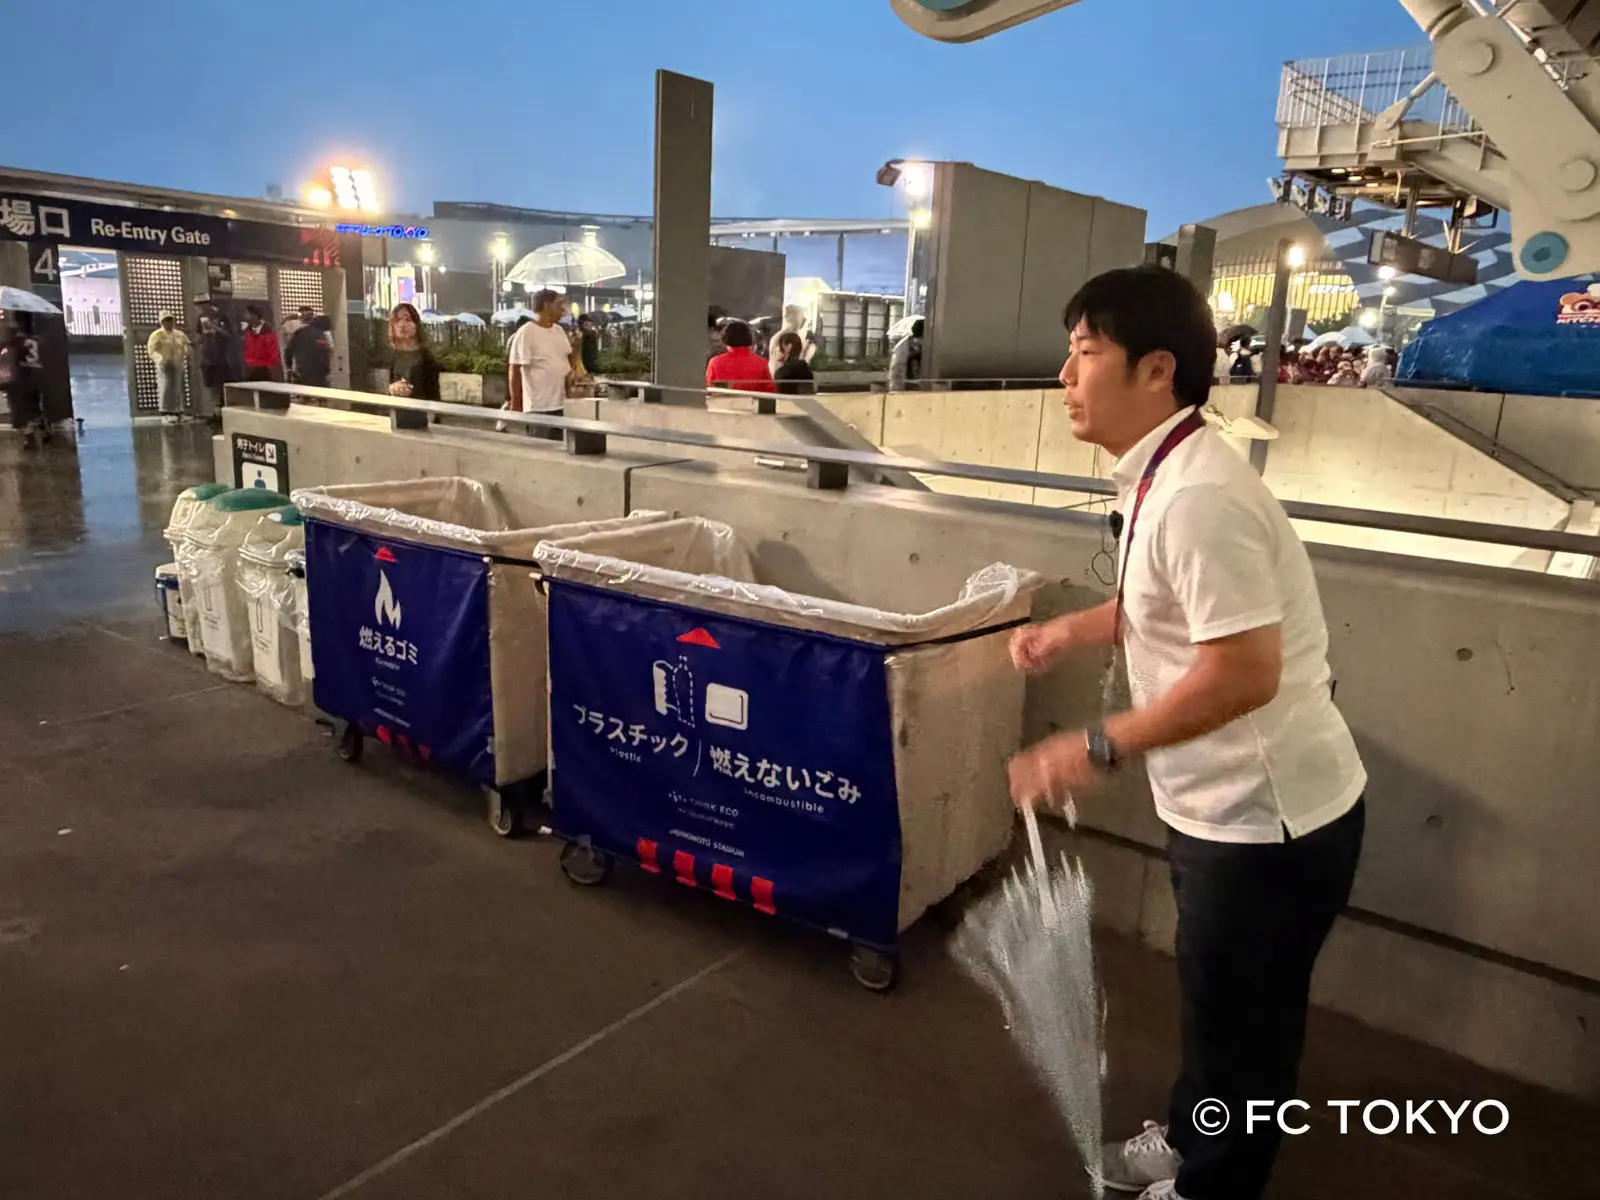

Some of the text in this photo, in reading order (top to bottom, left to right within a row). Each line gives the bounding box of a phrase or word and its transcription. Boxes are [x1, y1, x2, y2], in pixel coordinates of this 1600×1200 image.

[91, 218, 210, 245] Re-Entry Gate
[34, 248, 57, 280] 4
[359, 625, 418, 665] 燃えるゴミ
[709, 745, 862, 804] 燃えないごみ
[719, 805, 739, 817] ECO
